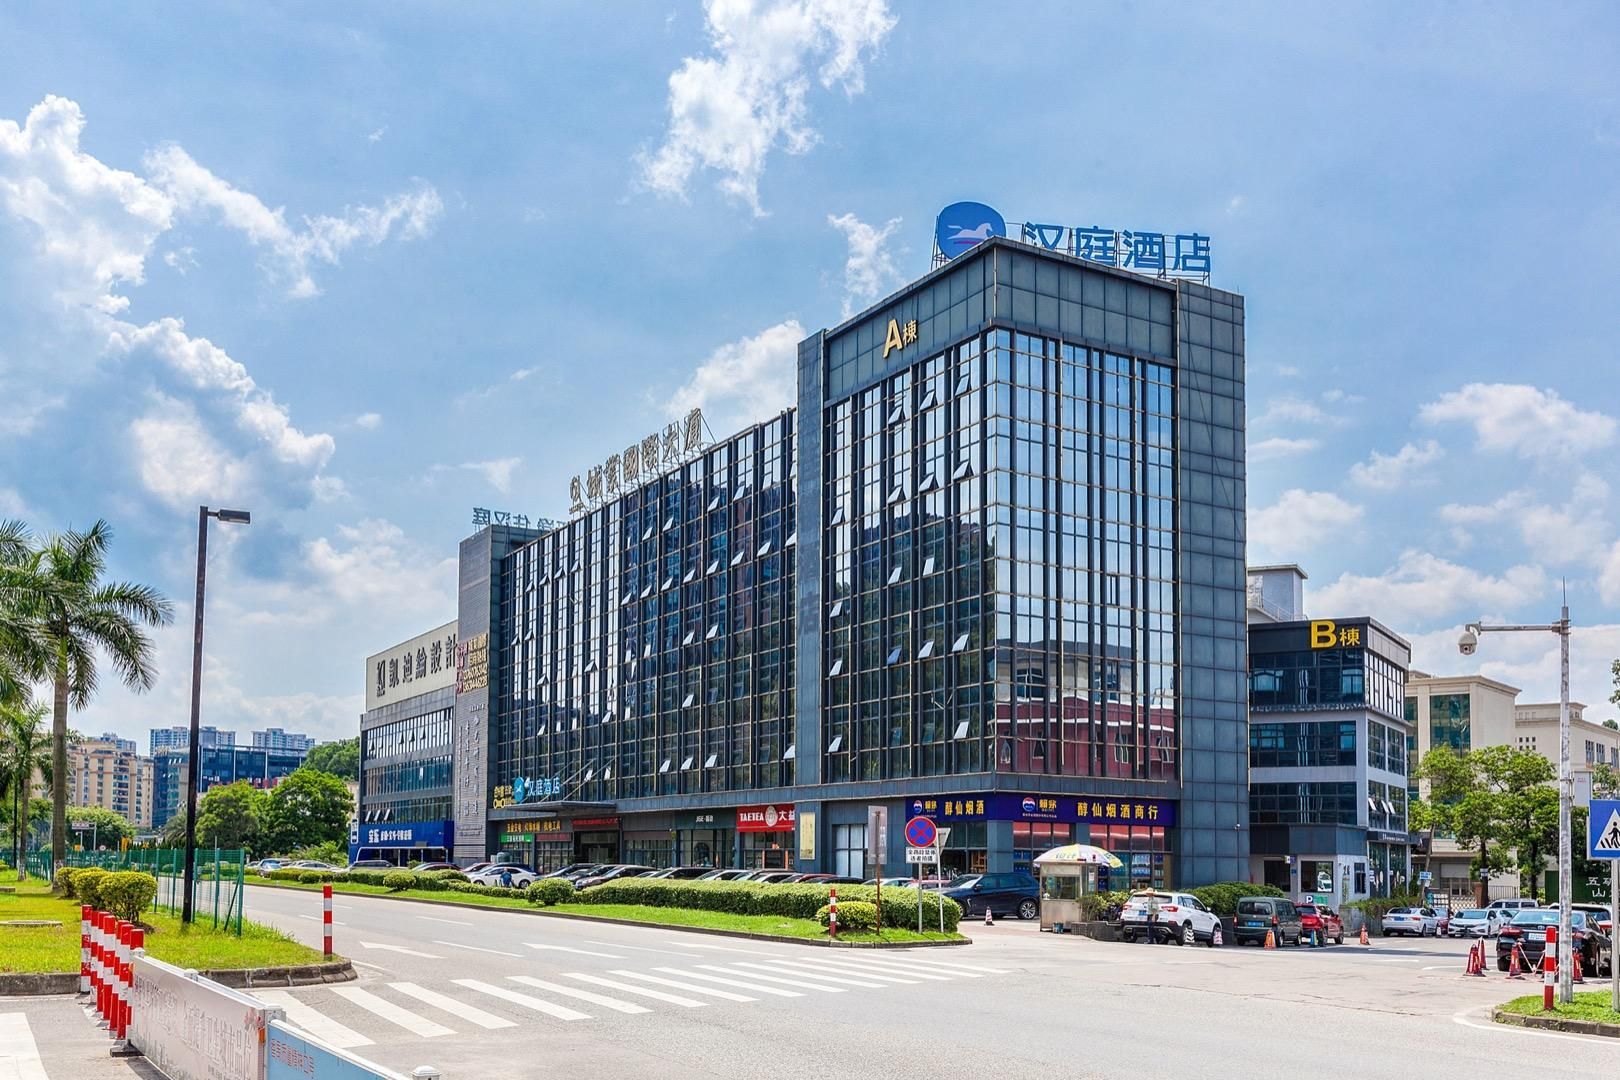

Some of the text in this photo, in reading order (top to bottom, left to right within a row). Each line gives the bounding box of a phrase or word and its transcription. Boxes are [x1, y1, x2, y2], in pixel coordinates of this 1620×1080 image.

[1025, 221, 1211, 272] 汉庭酒店
[740, 812, 764, 822] TAETEA
[1078, 802, 1158, 820] 醇仙烟酒商行
